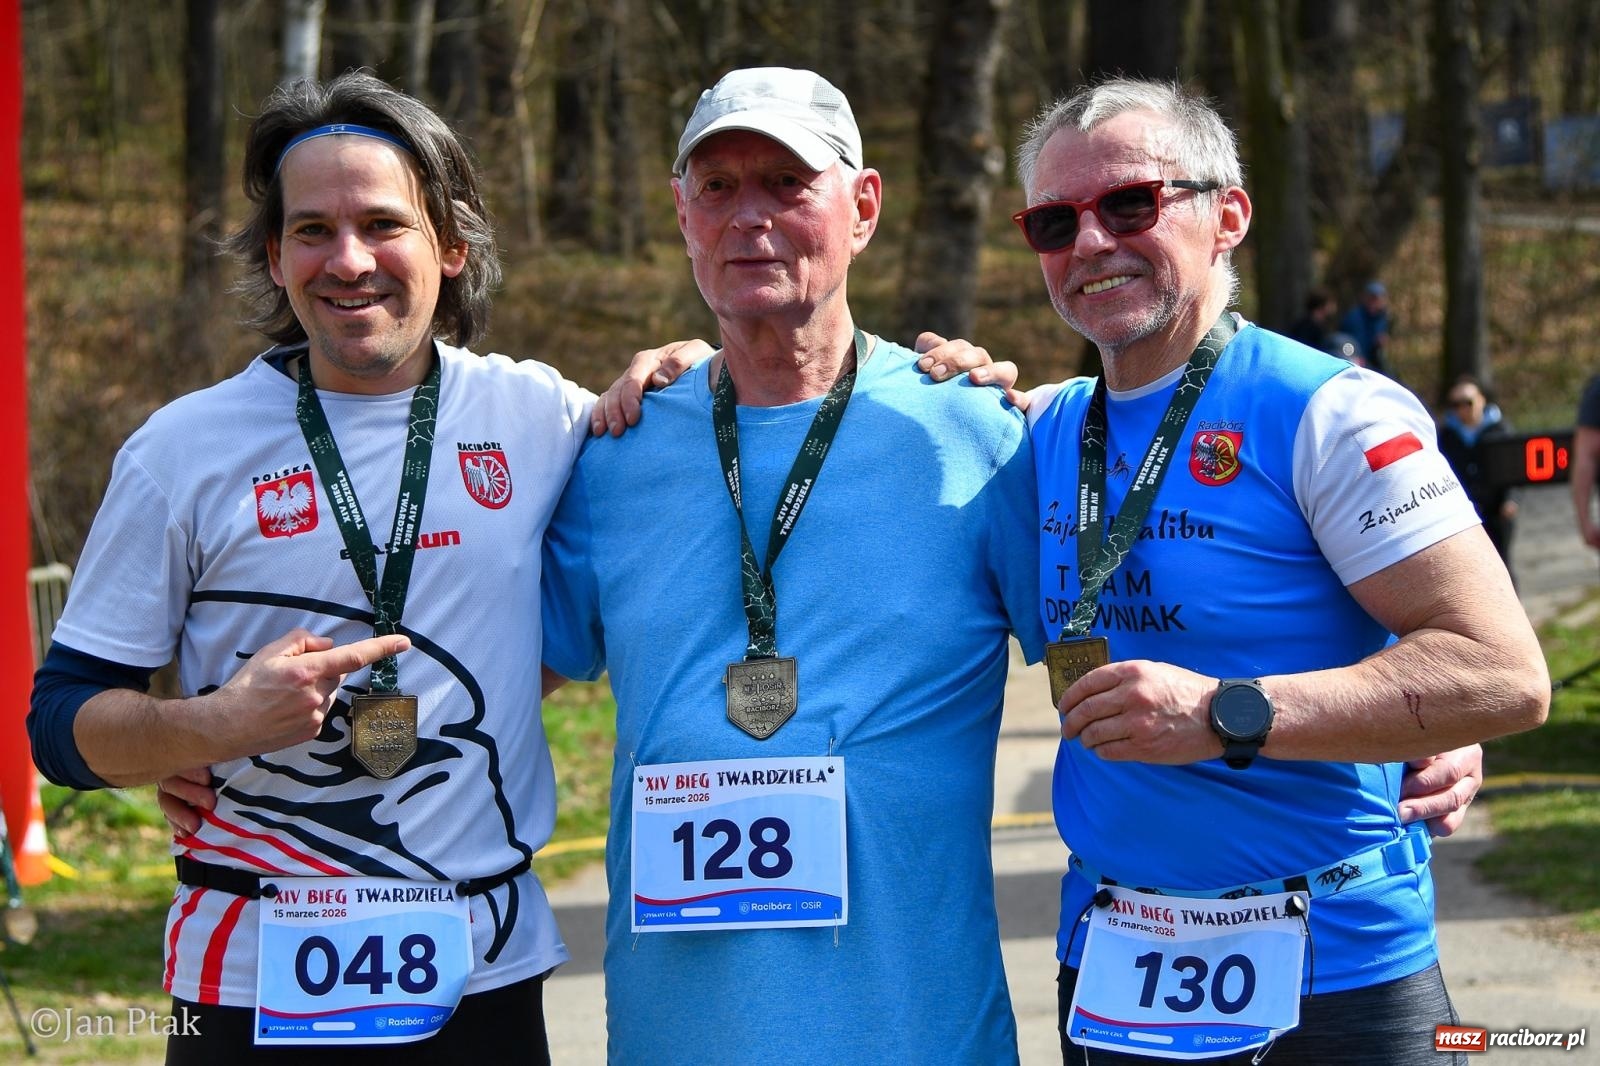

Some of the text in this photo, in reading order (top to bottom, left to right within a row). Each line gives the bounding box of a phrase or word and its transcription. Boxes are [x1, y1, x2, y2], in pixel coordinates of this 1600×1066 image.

[252, 463, 312, 484] POLSKA
[1132, 436, 1164, 491] TWARDZIELA
[1147, 447, 1169, 485] XIV BIEG
[331, 483, 351, 523] XIV BIEG
[337, 470, 364, 530] TWARDZIELA
[777, 483, 799, 522] XIV BIEG
[780, 479, 812, 535] TWARDZIELA
[1080, 484, 1089, 532] TWARDZIELA
[1090, 492, 1099, 522] XIV BIEG
[392, 492, 410, 553] TWARDZIELA
[404, 504, 418, 545] XIV BIEG
[1056, 565, 1152, 597] TAM
[1045, 598, 1187, 632] DRWNIAK
[645, 769, 827, 791] XIV BIEG TWARDZIELA
[645, 793, 710, 805] 15 marzec 2026
[673, 817, 793, 881] 128
[274, 909, 347, 918] 15 marzec 2026
[275, 888, 455, 904] XIV BIEG TWARDZIELA
[751, 901, 822, 911] Racibórz OSiR
[1111, 899, 1135, 915] XIV
[1141, 904, 1174, 924] BIEG
[1107, 916, 1176, 937] 15 marzec 2026
[295, 934, 438, 996] 048
[1134, 951, 1256, 1015] 130
[388, 1017, 425, 1027] Racibórz
